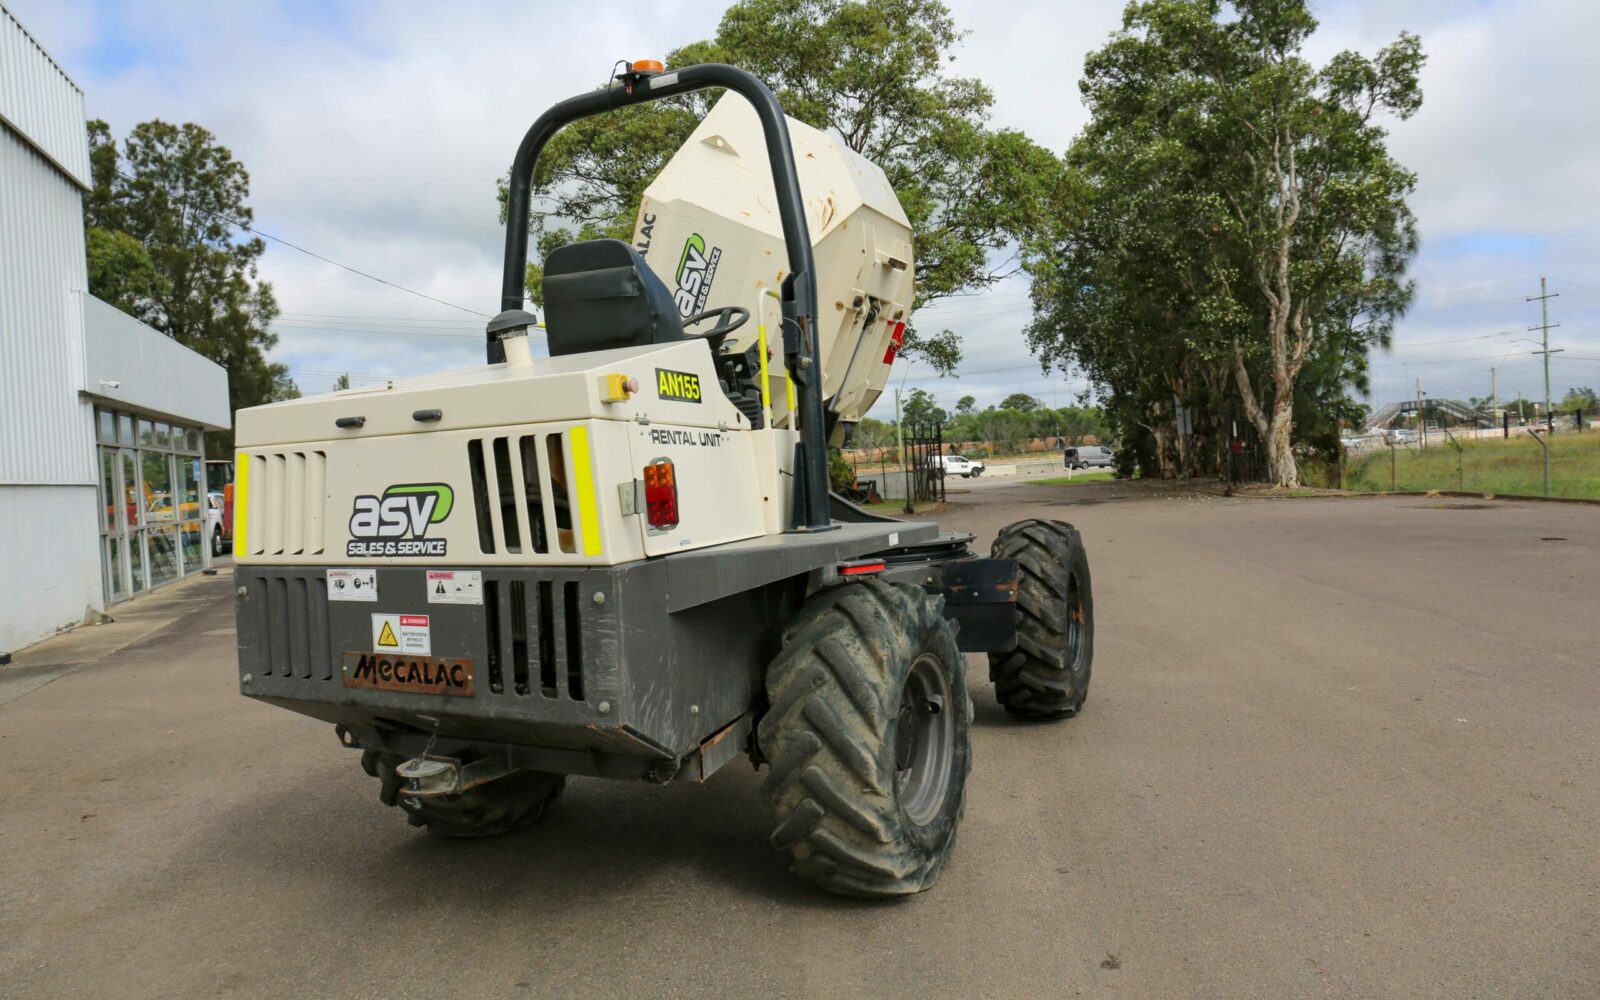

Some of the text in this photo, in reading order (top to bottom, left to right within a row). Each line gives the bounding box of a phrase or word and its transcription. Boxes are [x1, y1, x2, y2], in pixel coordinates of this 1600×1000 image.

[704, 249, 721, 285] SERVICE
[660, 371, 700, 400] AN155
[651, 429, 721, 447] RENTAL UNIT
[385, 542, 397, 555] &
[397, 541, 445, 555] SERVICE
